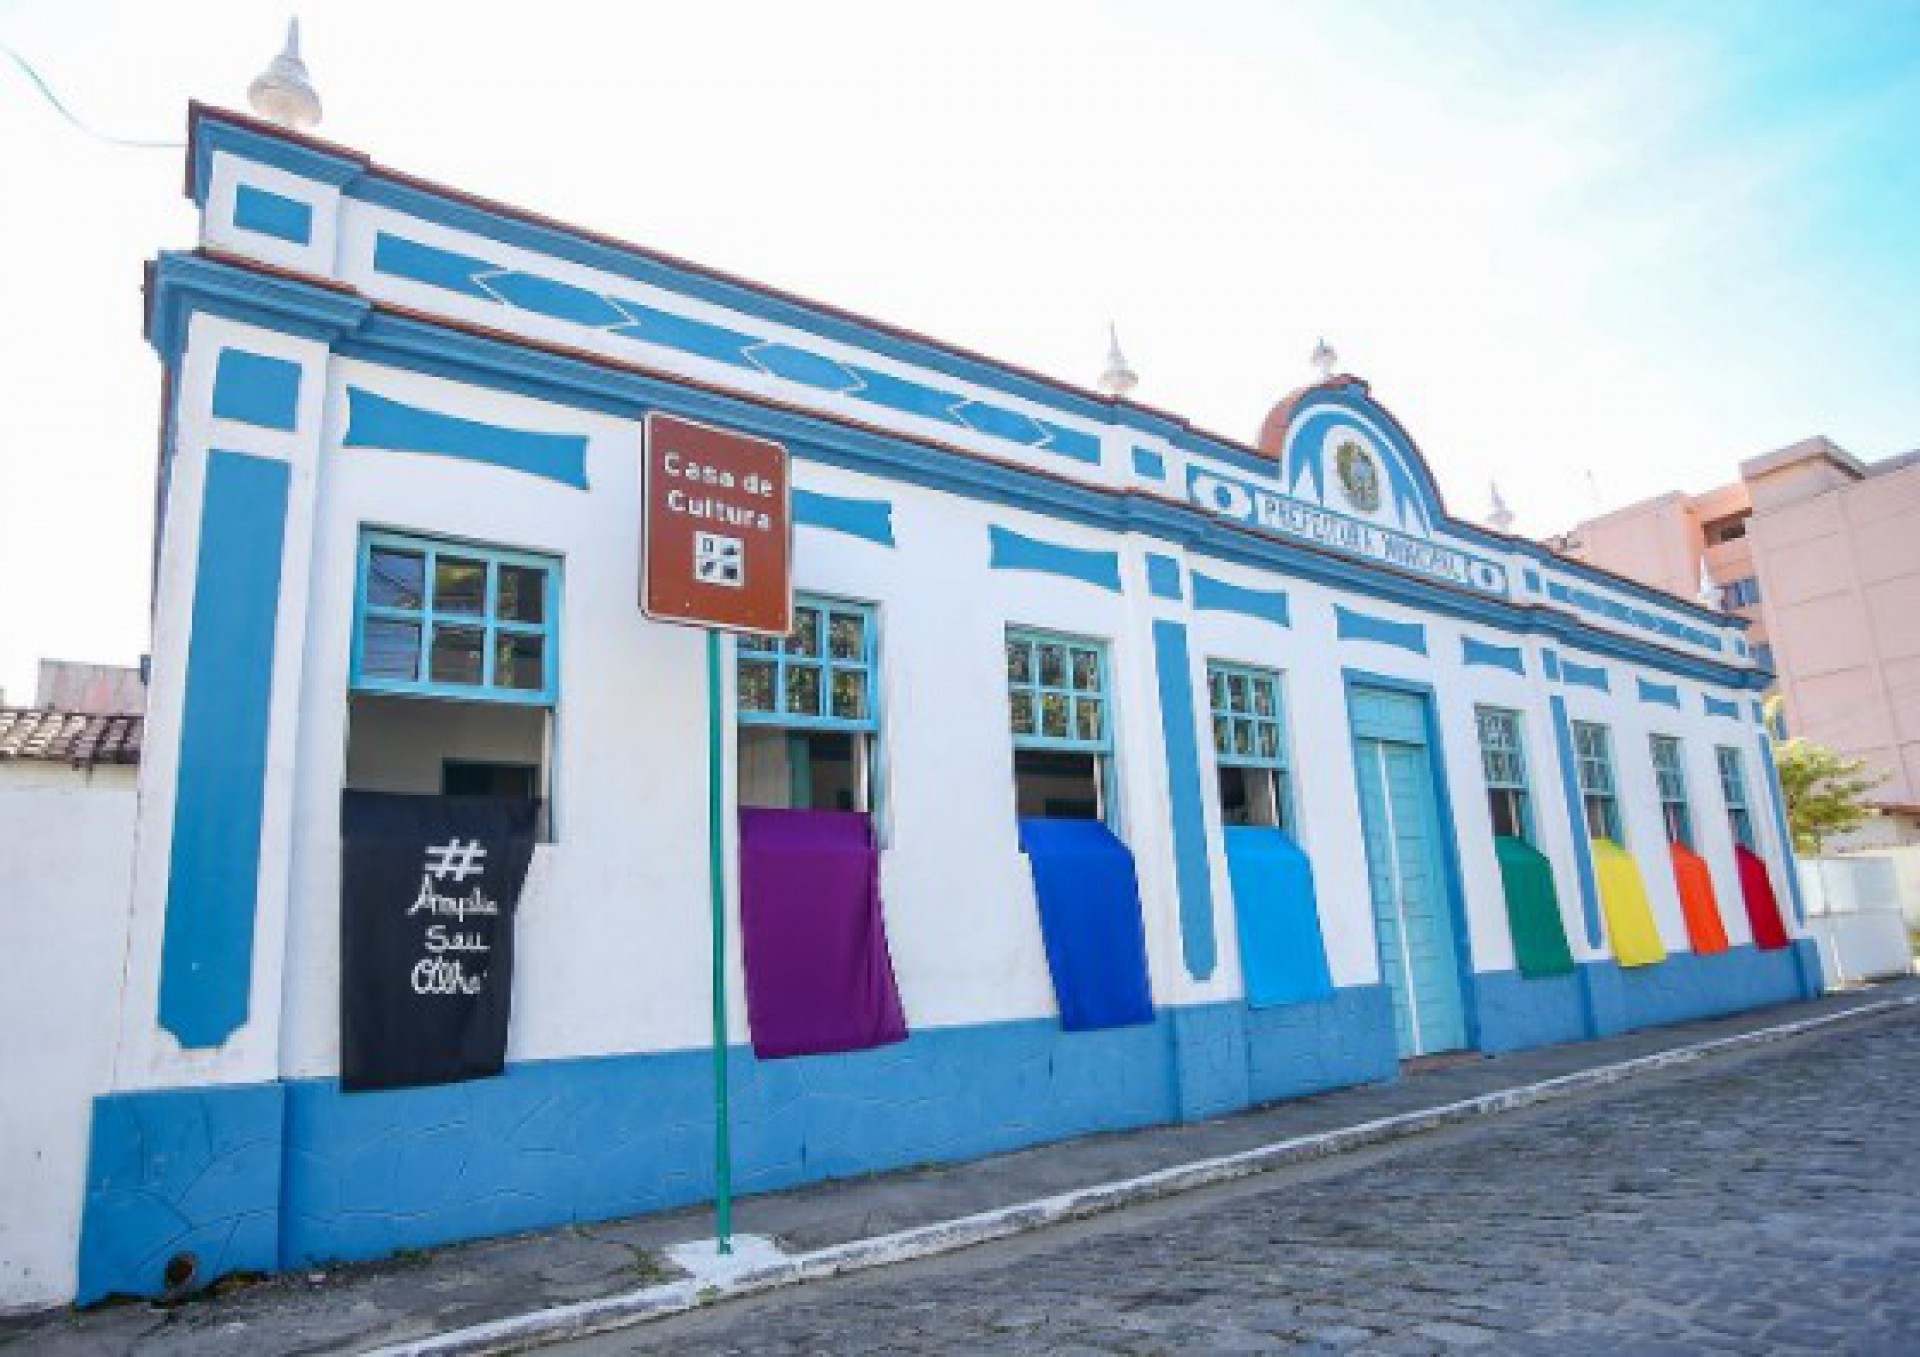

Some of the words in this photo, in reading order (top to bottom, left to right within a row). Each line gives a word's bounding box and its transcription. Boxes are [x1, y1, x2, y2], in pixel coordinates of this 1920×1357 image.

[664, 452, 735, 488] Casa
[743, 473, 773, 498] de
[667, 489, 770, 530] Cultura
